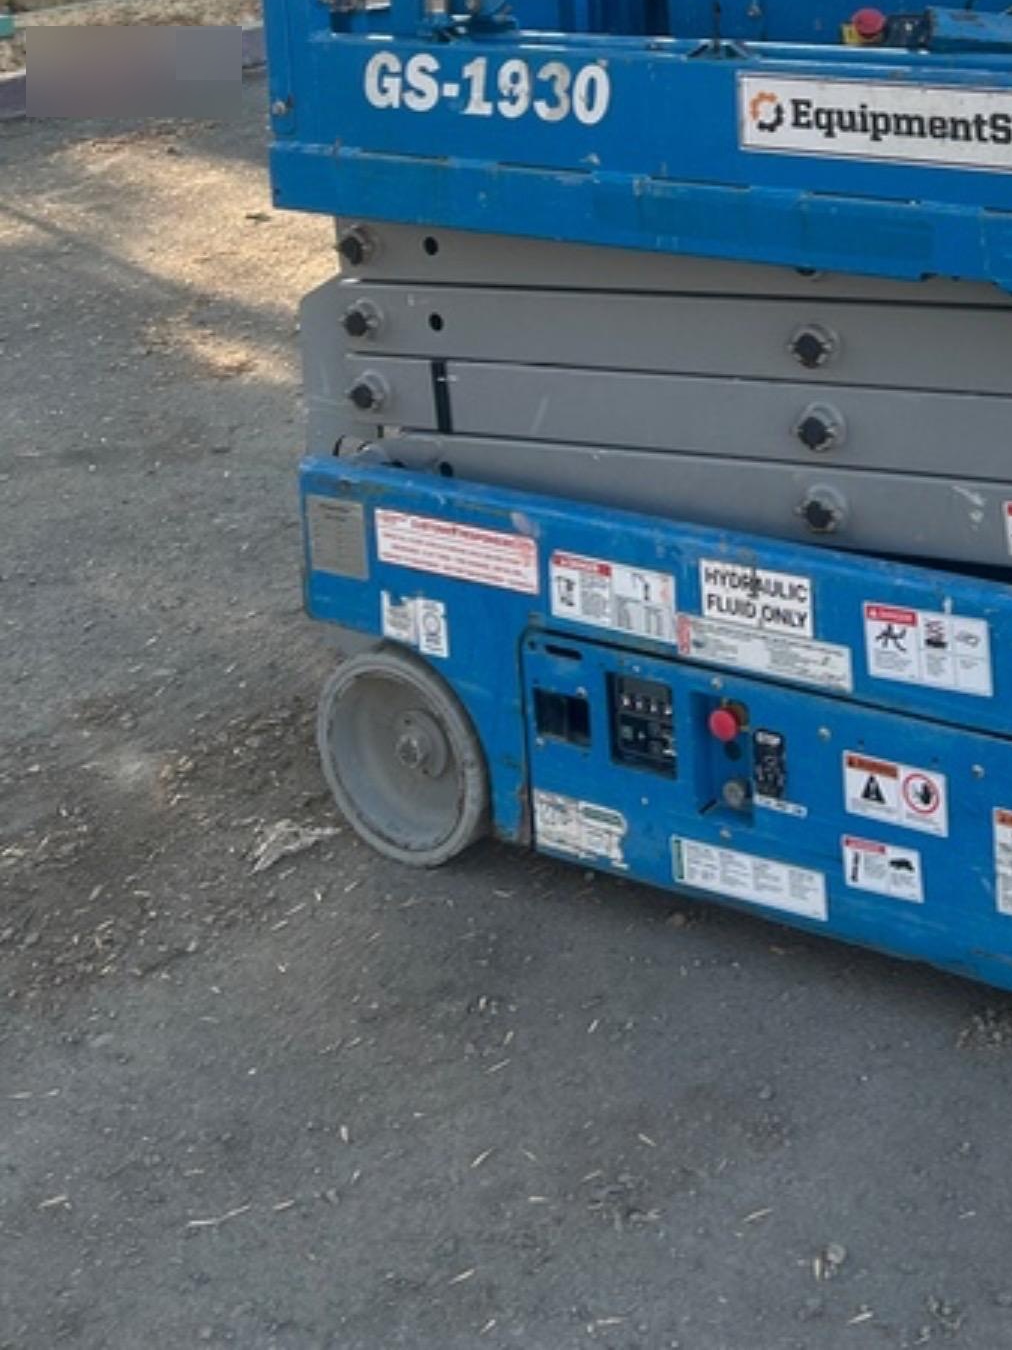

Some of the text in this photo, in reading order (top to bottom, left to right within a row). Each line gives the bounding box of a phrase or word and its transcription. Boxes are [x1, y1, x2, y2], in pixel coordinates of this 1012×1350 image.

[364, 50, 611, 126] GS-1930
[707, 593, 807, 627] FLUID ONLY
